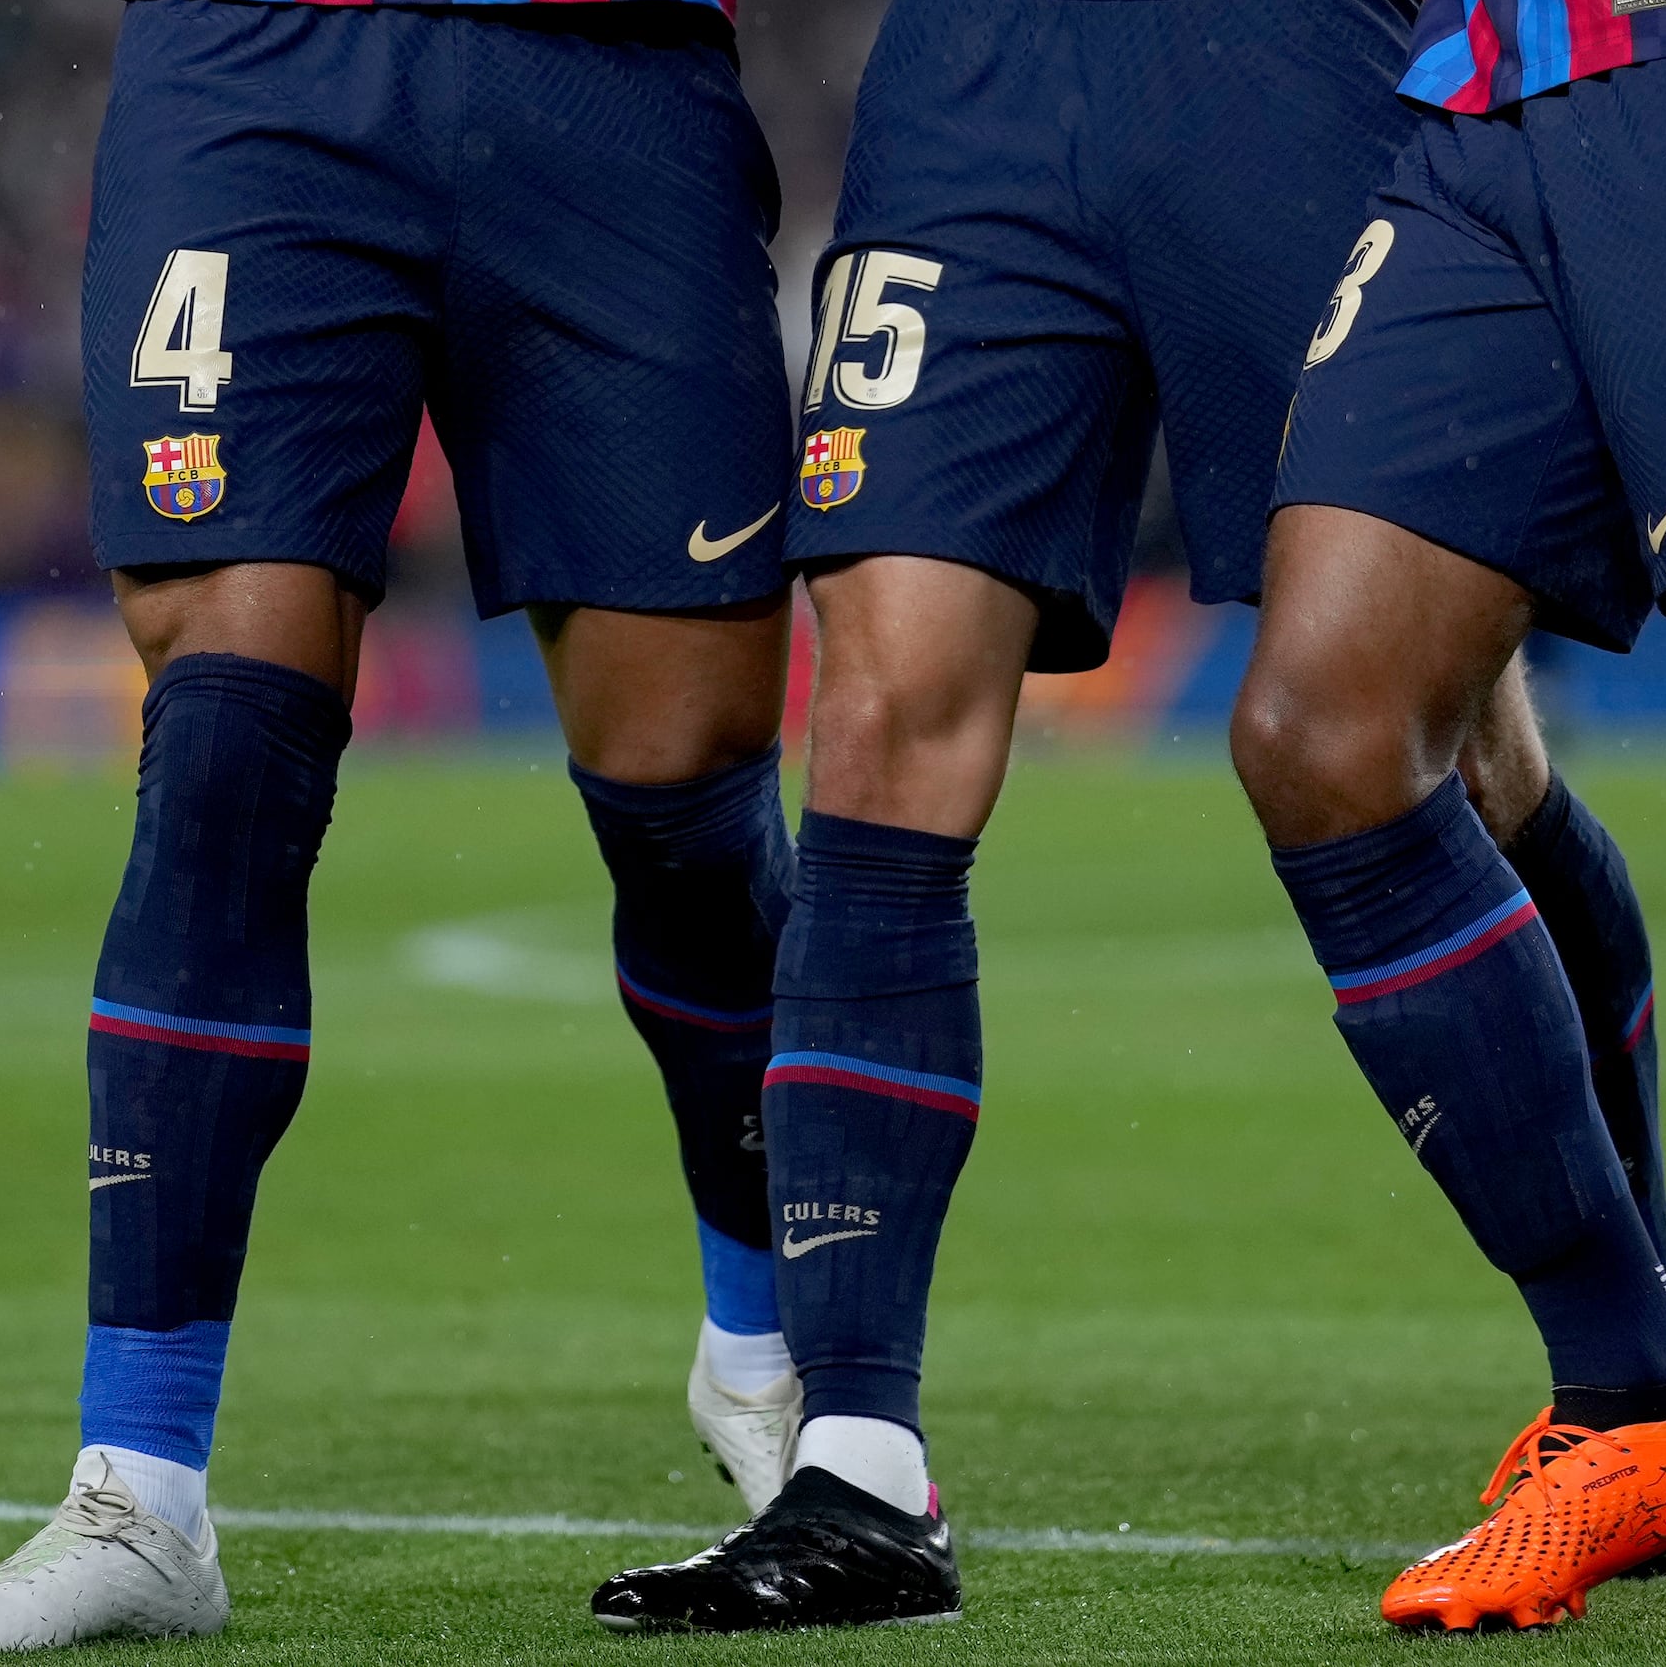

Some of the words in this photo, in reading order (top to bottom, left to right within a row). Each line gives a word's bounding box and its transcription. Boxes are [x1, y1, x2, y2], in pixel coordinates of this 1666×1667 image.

[130, 248, 233, 413] 4
[803, 250, 944, 415] 15
[167, 469, 199, 483] FCB
[814, 461, 841, 474] FCB
[783, 1201, 881, 1225] CULERS
[1581, 1465, 1641, 1493] PREDATOR
